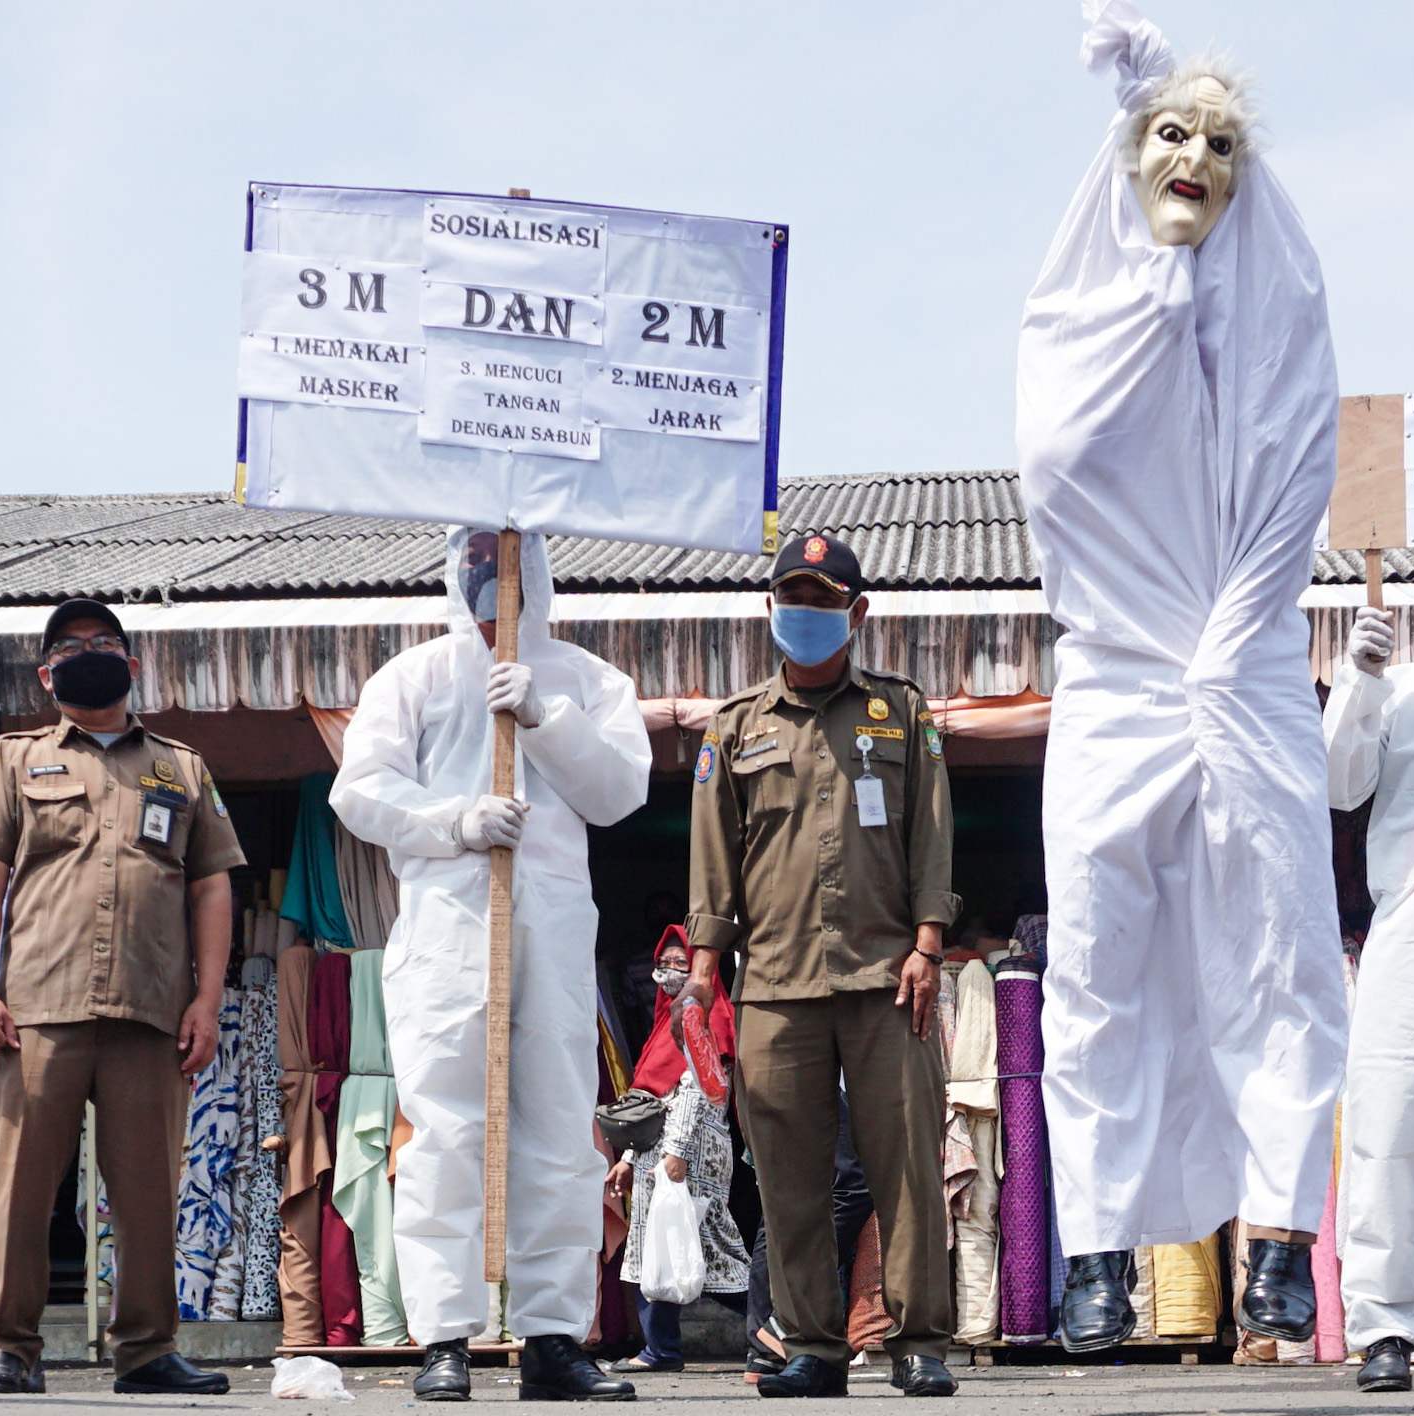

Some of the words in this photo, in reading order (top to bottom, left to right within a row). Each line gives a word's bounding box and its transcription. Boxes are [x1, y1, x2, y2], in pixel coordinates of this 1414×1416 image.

[430, 212, 601, 250] SOSIALISASI
[297, 268, 328, 309] 3
[345, 272, 388, 314] M
[463, 286, 576, 340] DAN
[640, 301, 671, 345] 2
[685, 306, 727, 350] M
[271, 336, 289, 356] 1.
[293, 337, 410, 365] MEMAKAI
[459, 360, 477, 378] 3.
[484, 362, 563, 385] MENCUCI
[611, 368, 630, 387] 2.
[635, 370, 739, 399] MENJAGA
[299, 375, 399, 403] MASKER
[483, 391, 561, 414] TANGAN
[451, 418, 527, 442] DENGAN
[530, 425, 593, 447] SABUN
[647, 407, 724, 433] JARAK
